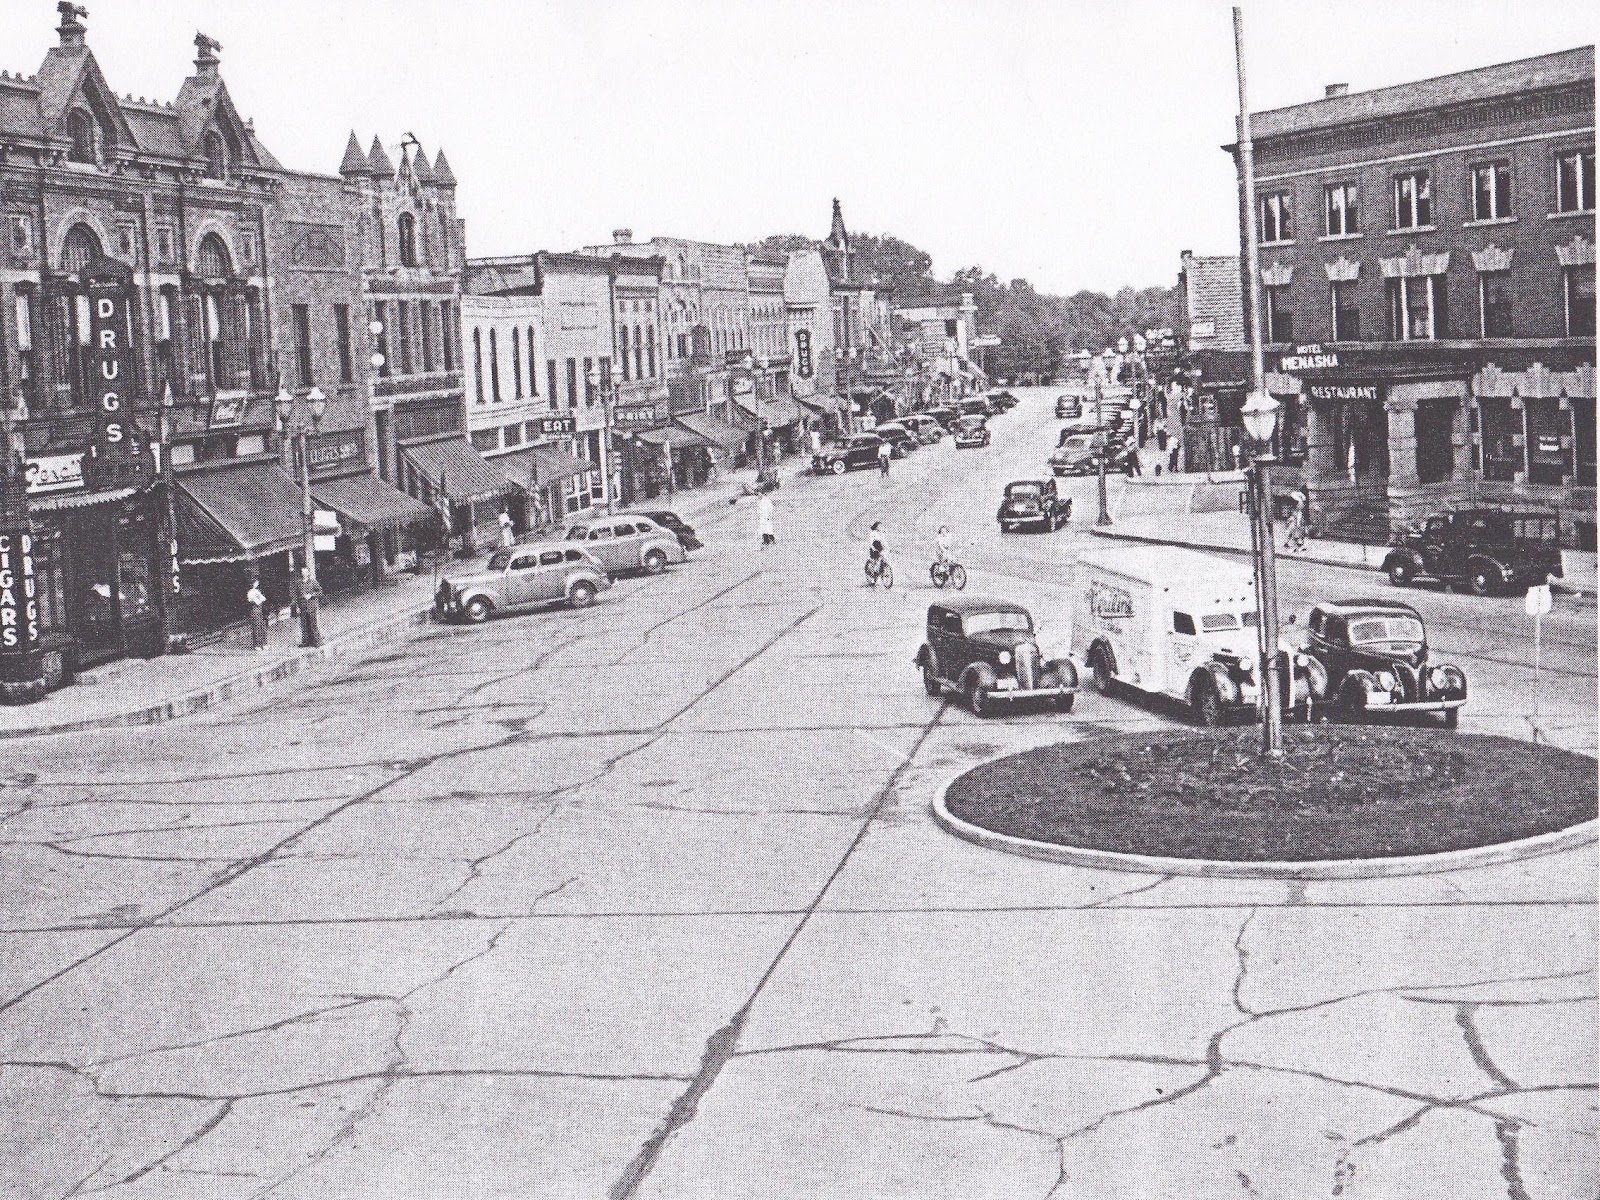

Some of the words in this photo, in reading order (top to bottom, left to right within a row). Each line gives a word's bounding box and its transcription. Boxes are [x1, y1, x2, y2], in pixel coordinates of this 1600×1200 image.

[800, 333, 808, 375] DRUGS
[1281, 354, 1338, 370] MENASHA
[1296, 344, 1321, 354] HOTEL
[98, 299, 123, 442] DRUGS
[1311, 386, 1377, 399] RESTAURANT
[543, 420, 571, 432] EAT
[0, 535, 17, 646] CIGARS
[22, 535, 38, 640] DRUGS
